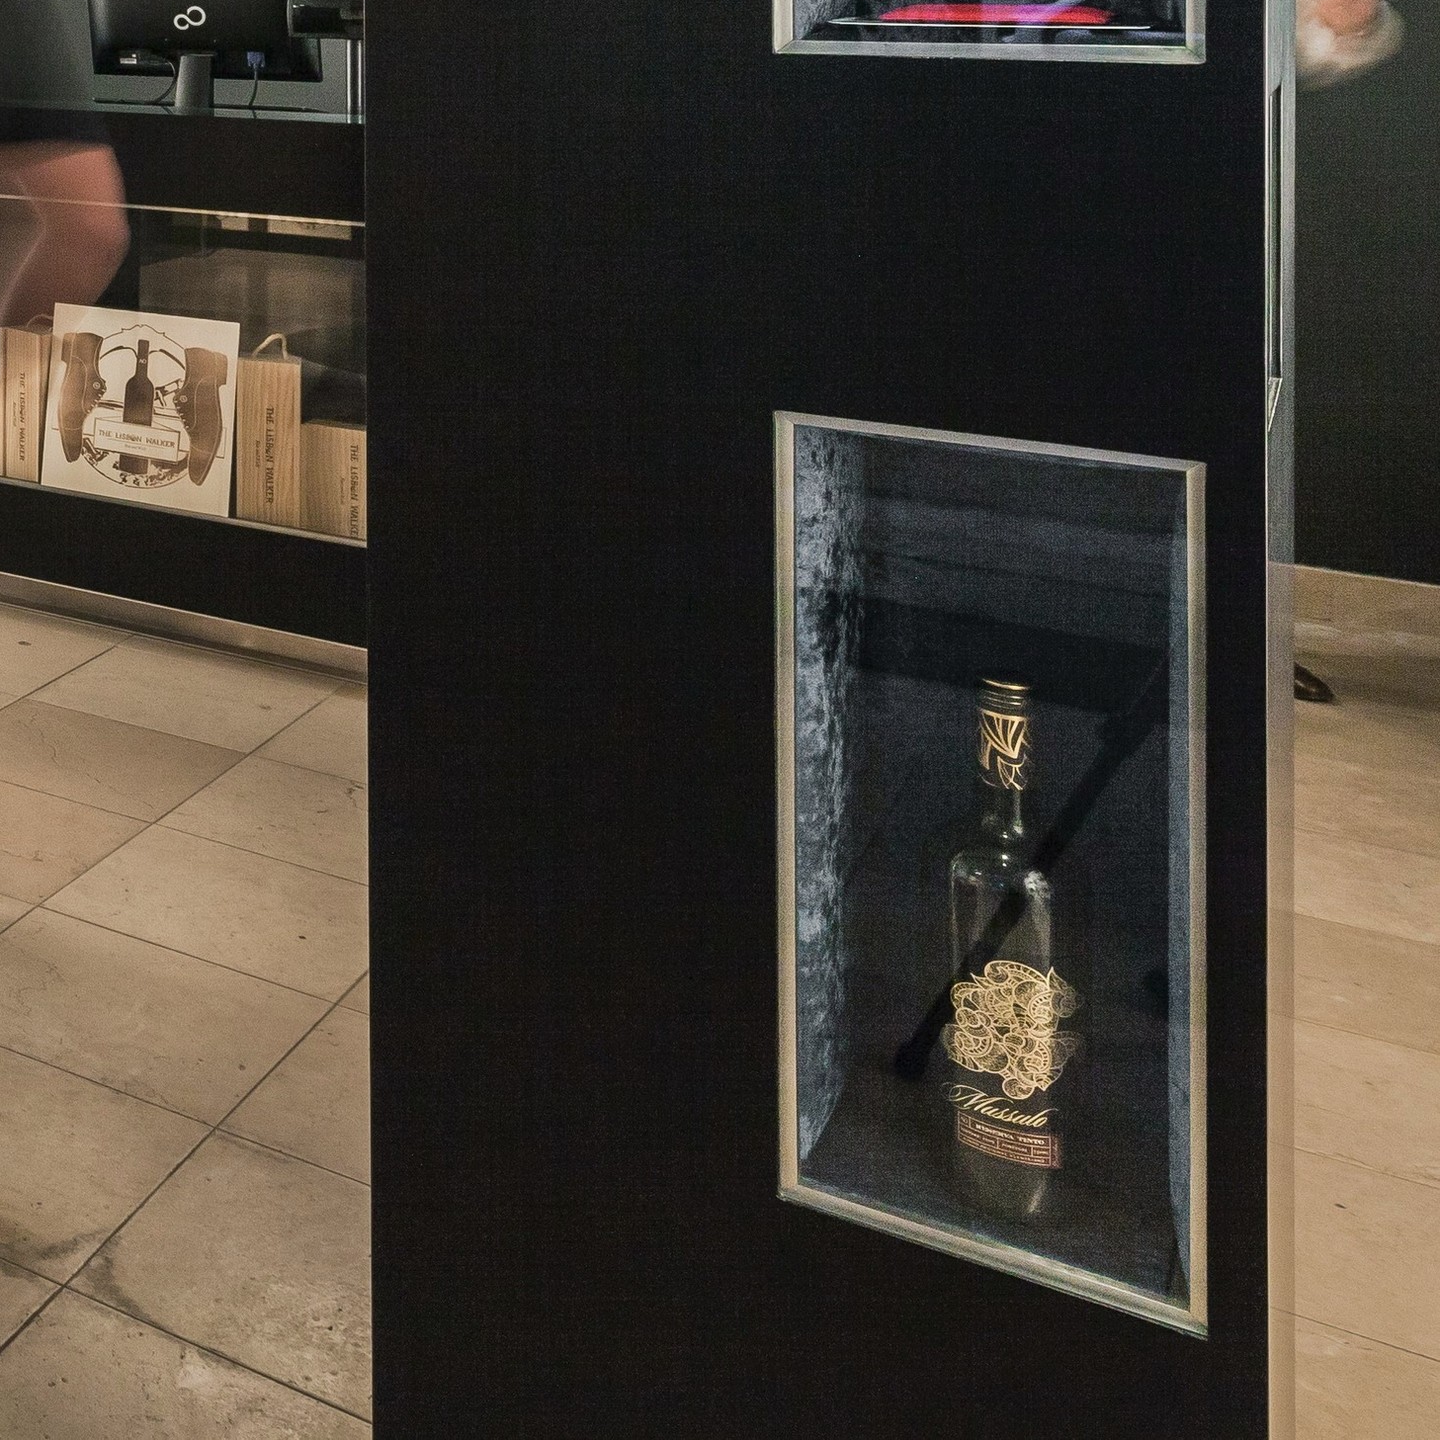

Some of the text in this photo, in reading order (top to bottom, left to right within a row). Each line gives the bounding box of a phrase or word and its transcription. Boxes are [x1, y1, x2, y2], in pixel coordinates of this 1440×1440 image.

[98, 429, 112, 438] THE
[115, 432, 143, 443] LISBON
[145, 436, 176, 448] WALKER
[265, 407, 275, 504] THE LISBON WALKER
[350, 445, 359, 462] THE
[350, 505, 359, 539] WALKE
[946, 1083, 1059, 1128] Mussulo
